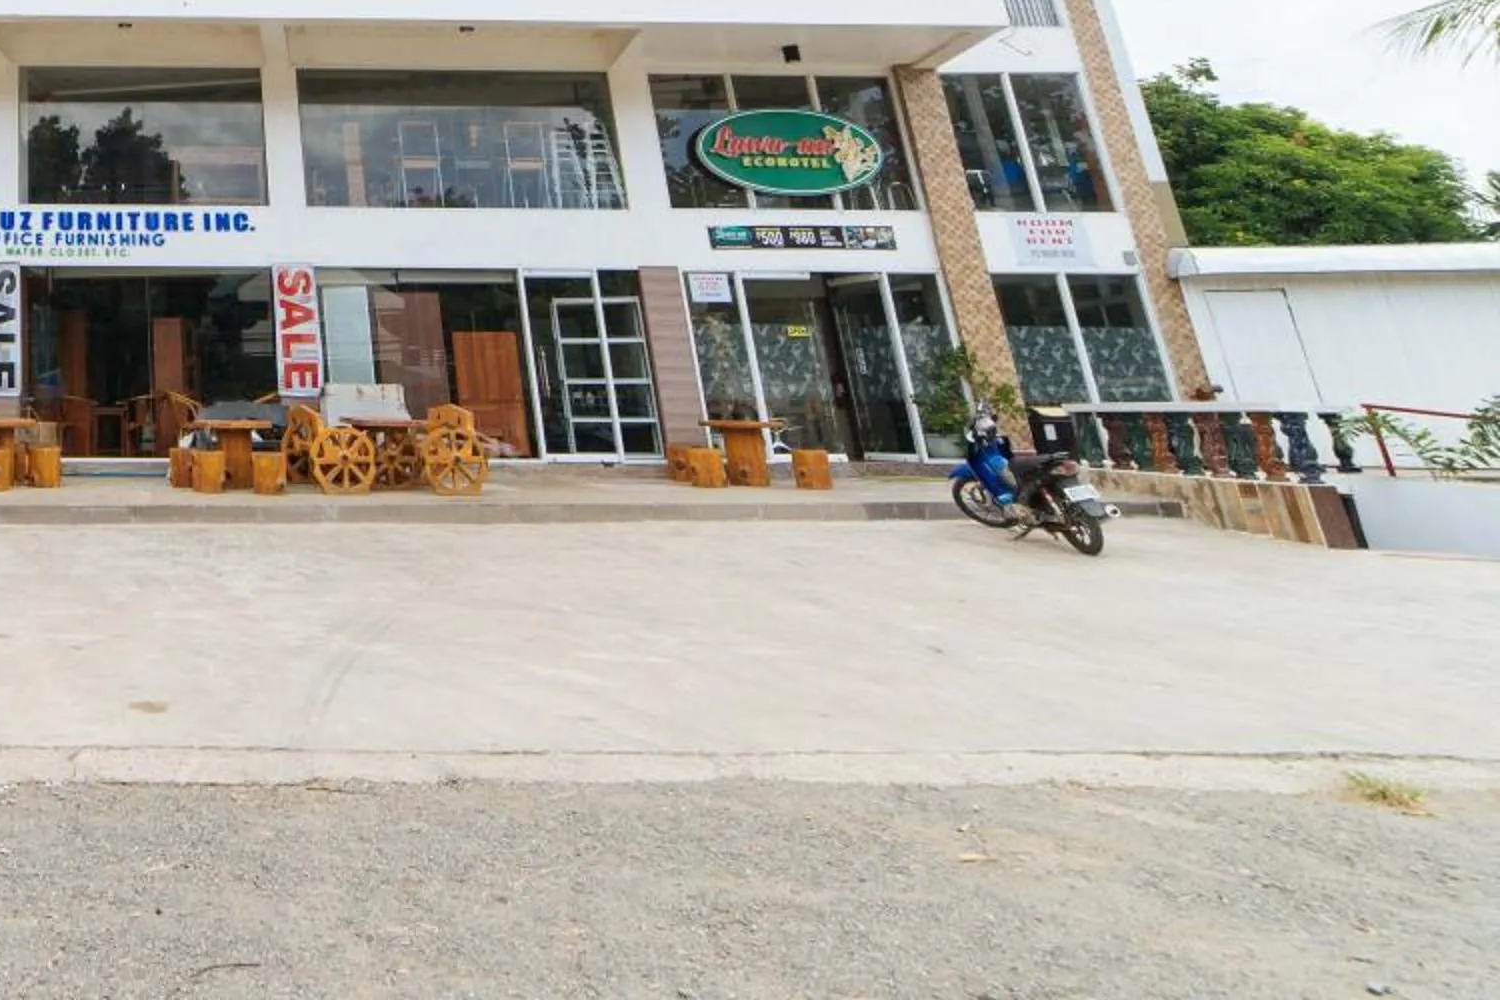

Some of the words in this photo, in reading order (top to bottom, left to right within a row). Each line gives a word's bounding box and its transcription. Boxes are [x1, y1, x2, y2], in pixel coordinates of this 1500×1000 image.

[42, 212, 194, 232] FURNITURE
[204, 212, 255, 232] INC.
[55, 232, 165, 247] FURNISHING
[277, 266, 319, 389] SALE
